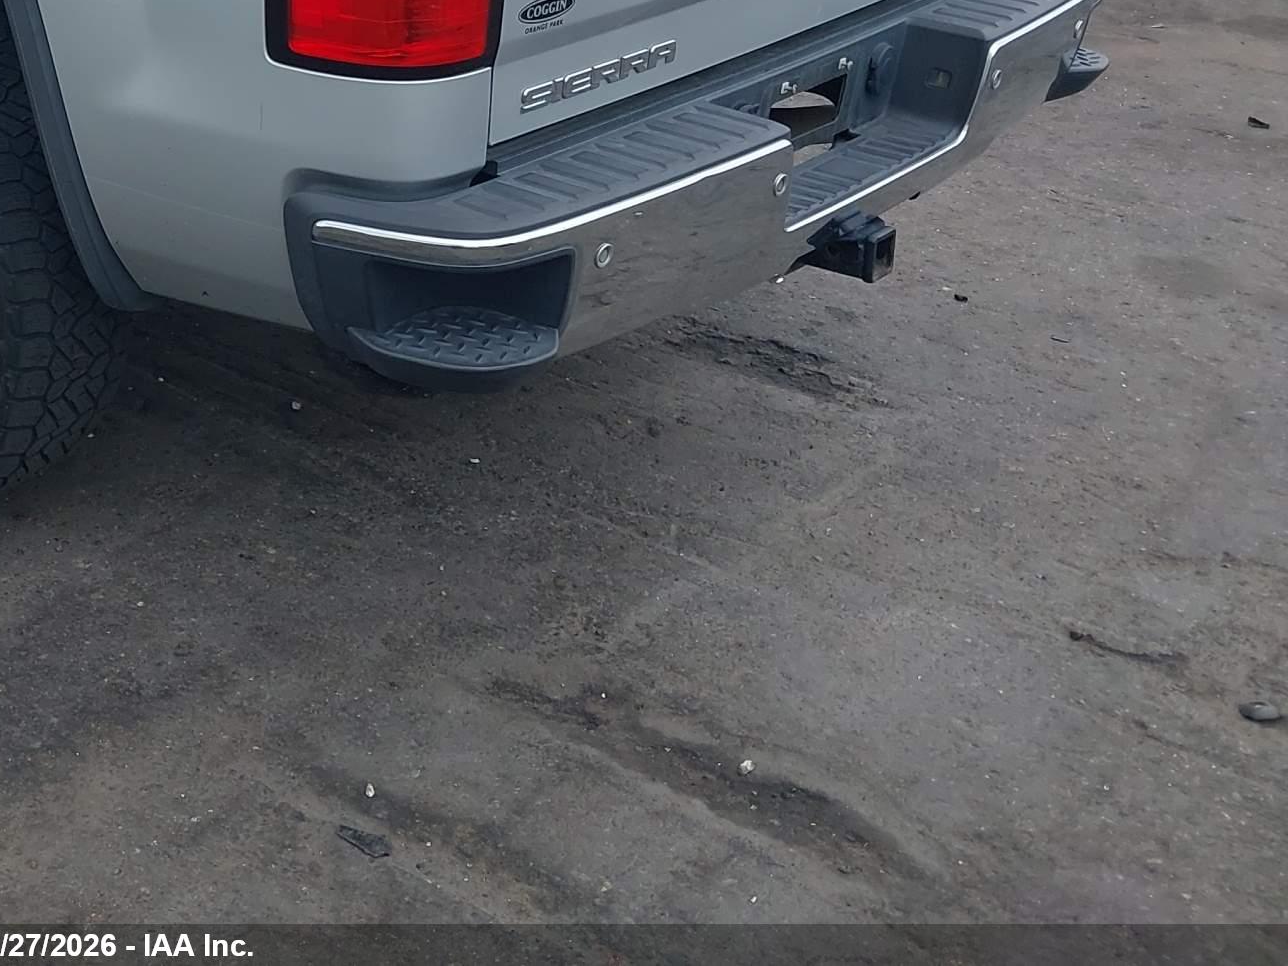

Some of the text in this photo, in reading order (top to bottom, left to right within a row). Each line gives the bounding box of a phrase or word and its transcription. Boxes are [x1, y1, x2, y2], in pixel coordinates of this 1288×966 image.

[524, 19, 564, 35] ORANGE PARK
[520, 39, 676, 115] SIERRA
